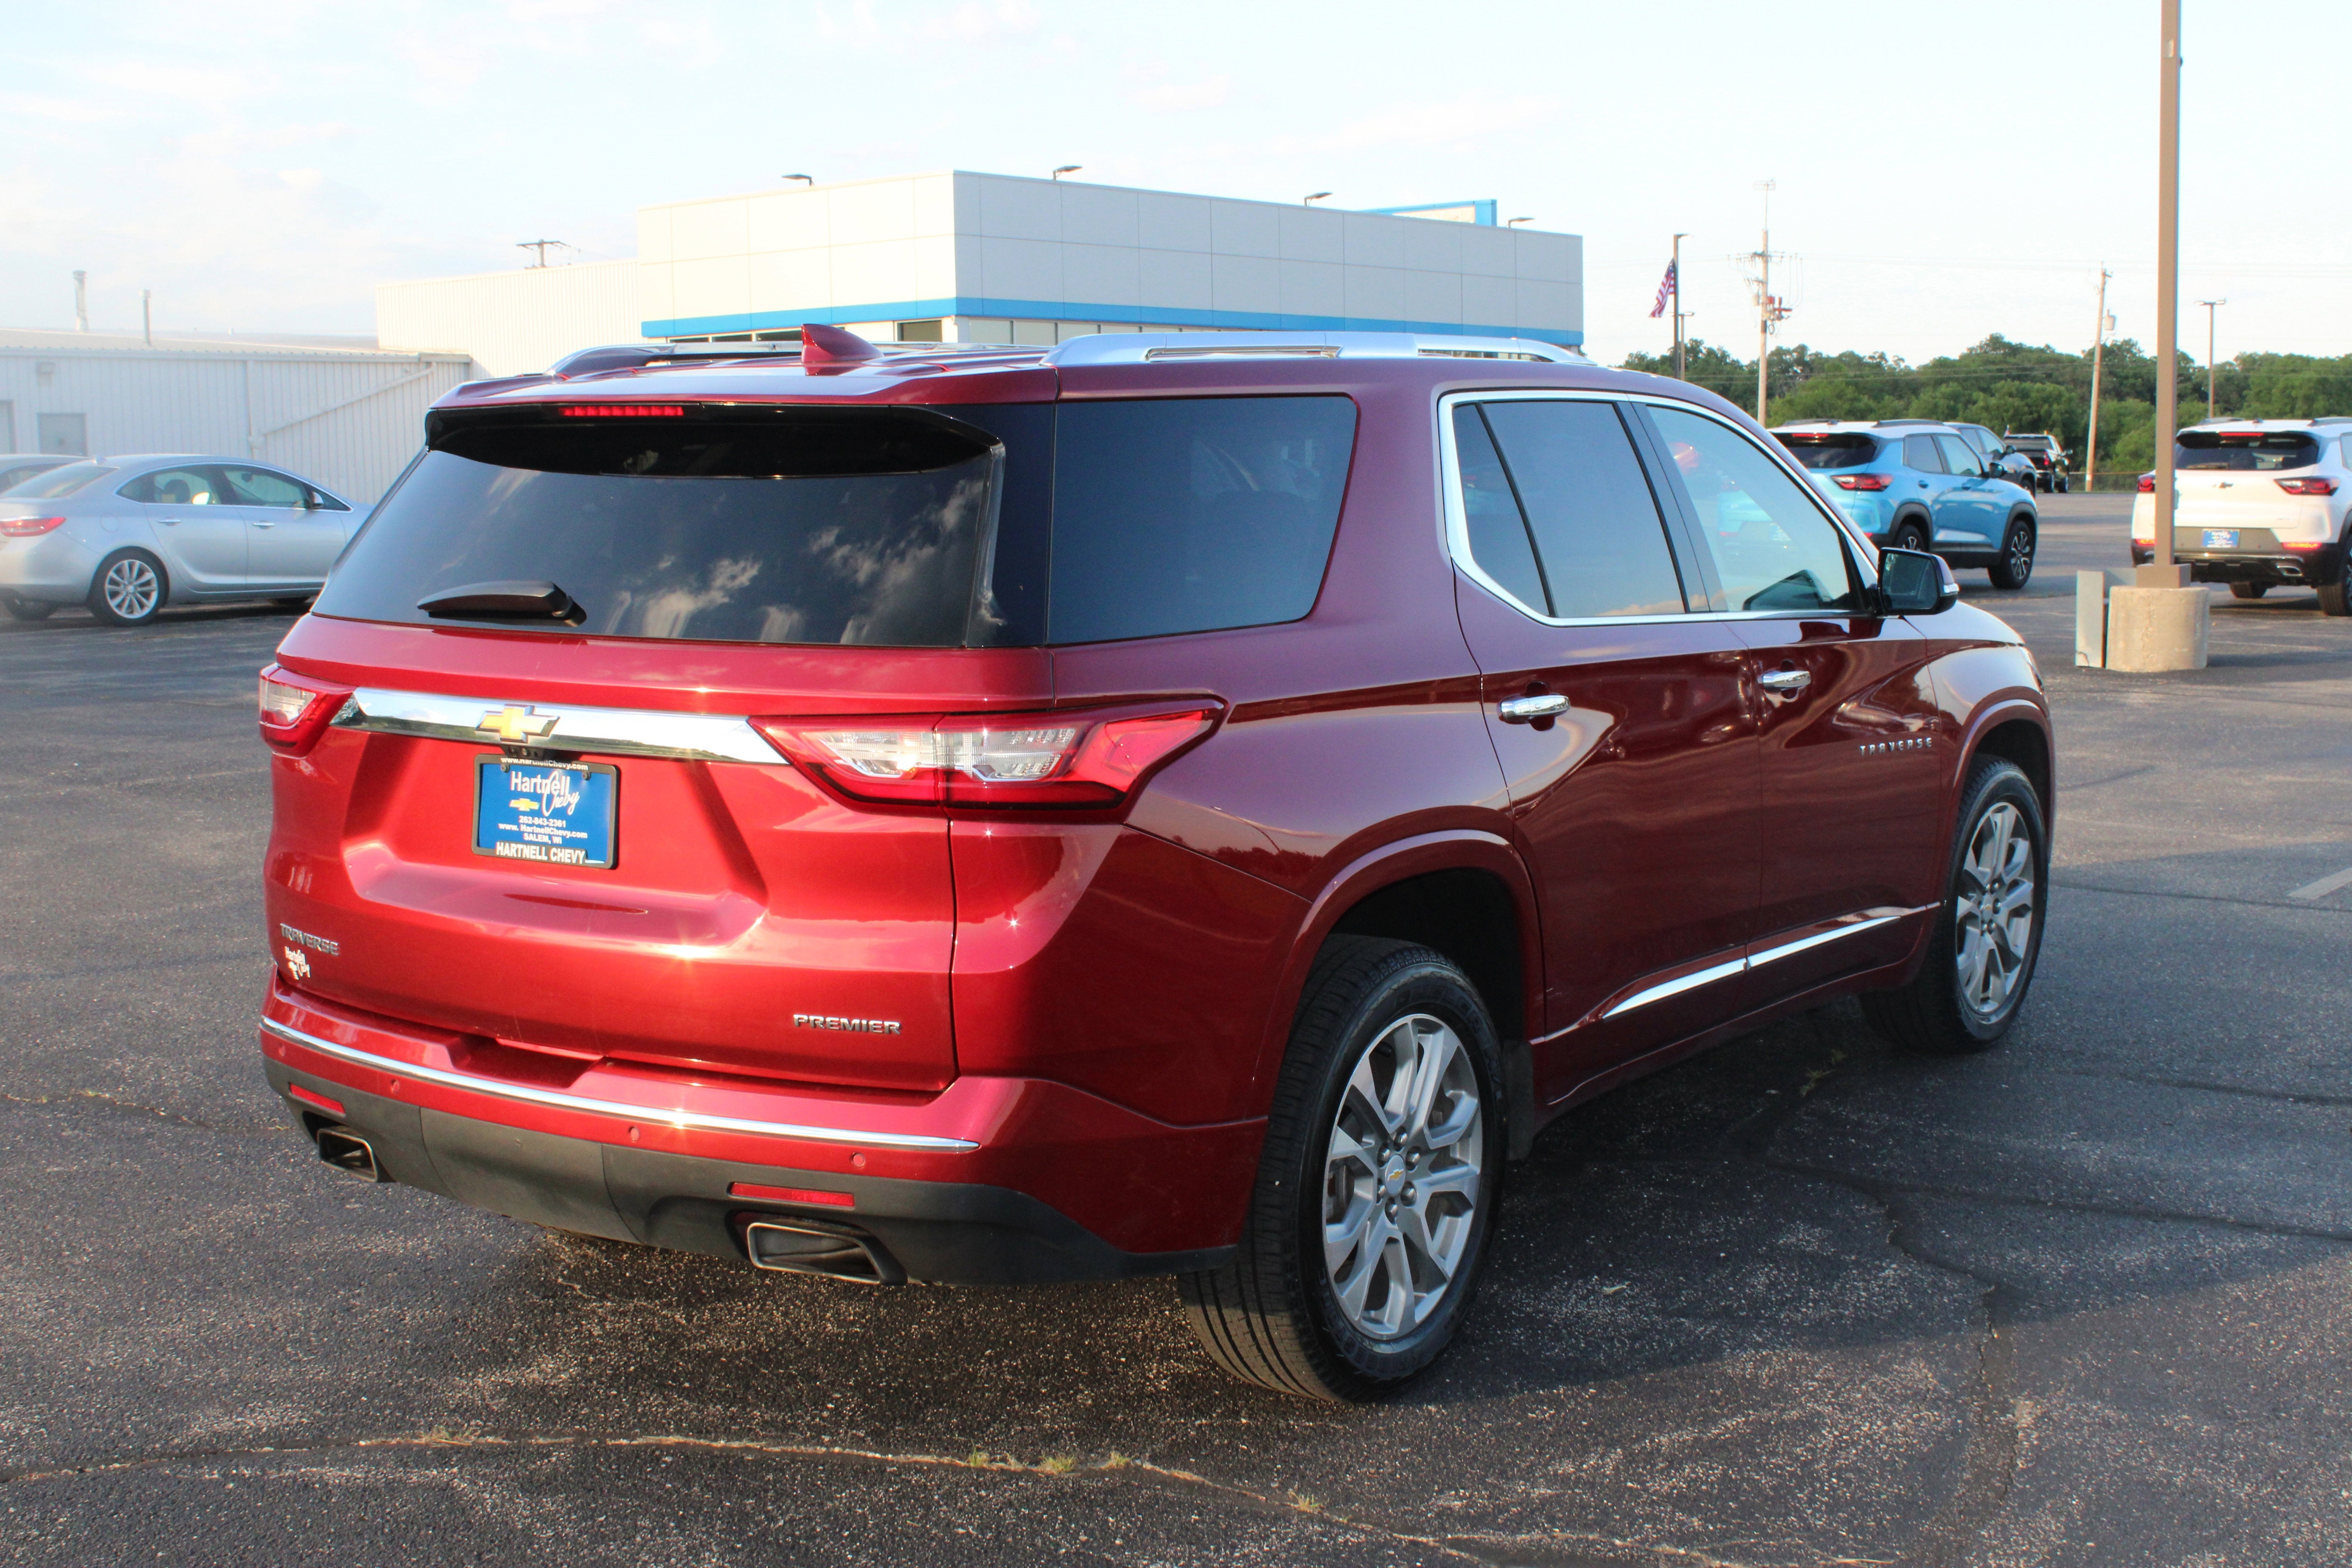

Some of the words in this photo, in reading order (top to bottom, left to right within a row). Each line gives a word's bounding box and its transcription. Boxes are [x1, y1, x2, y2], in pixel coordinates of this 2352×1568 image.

[1859, 737, 1932, 756] TRAVERSE
[511, 771, 571, 795] Hartnell
[541, 770, 580, 817] Chevy
[519, 815, 566, 828] 262-843-2361
[520, 824, 588, 838] HartnellChevy.com
[523, 833, 551, 844] SALEM,
[552, 836, 563, 844] WI
[496, 842, 548, 860] HARTNELL
[550, 848, 586, 864] CHEVY
[280, 923, 339, 956] TRAVERSE
[793, 1014, 901, 1035] PREMIER
